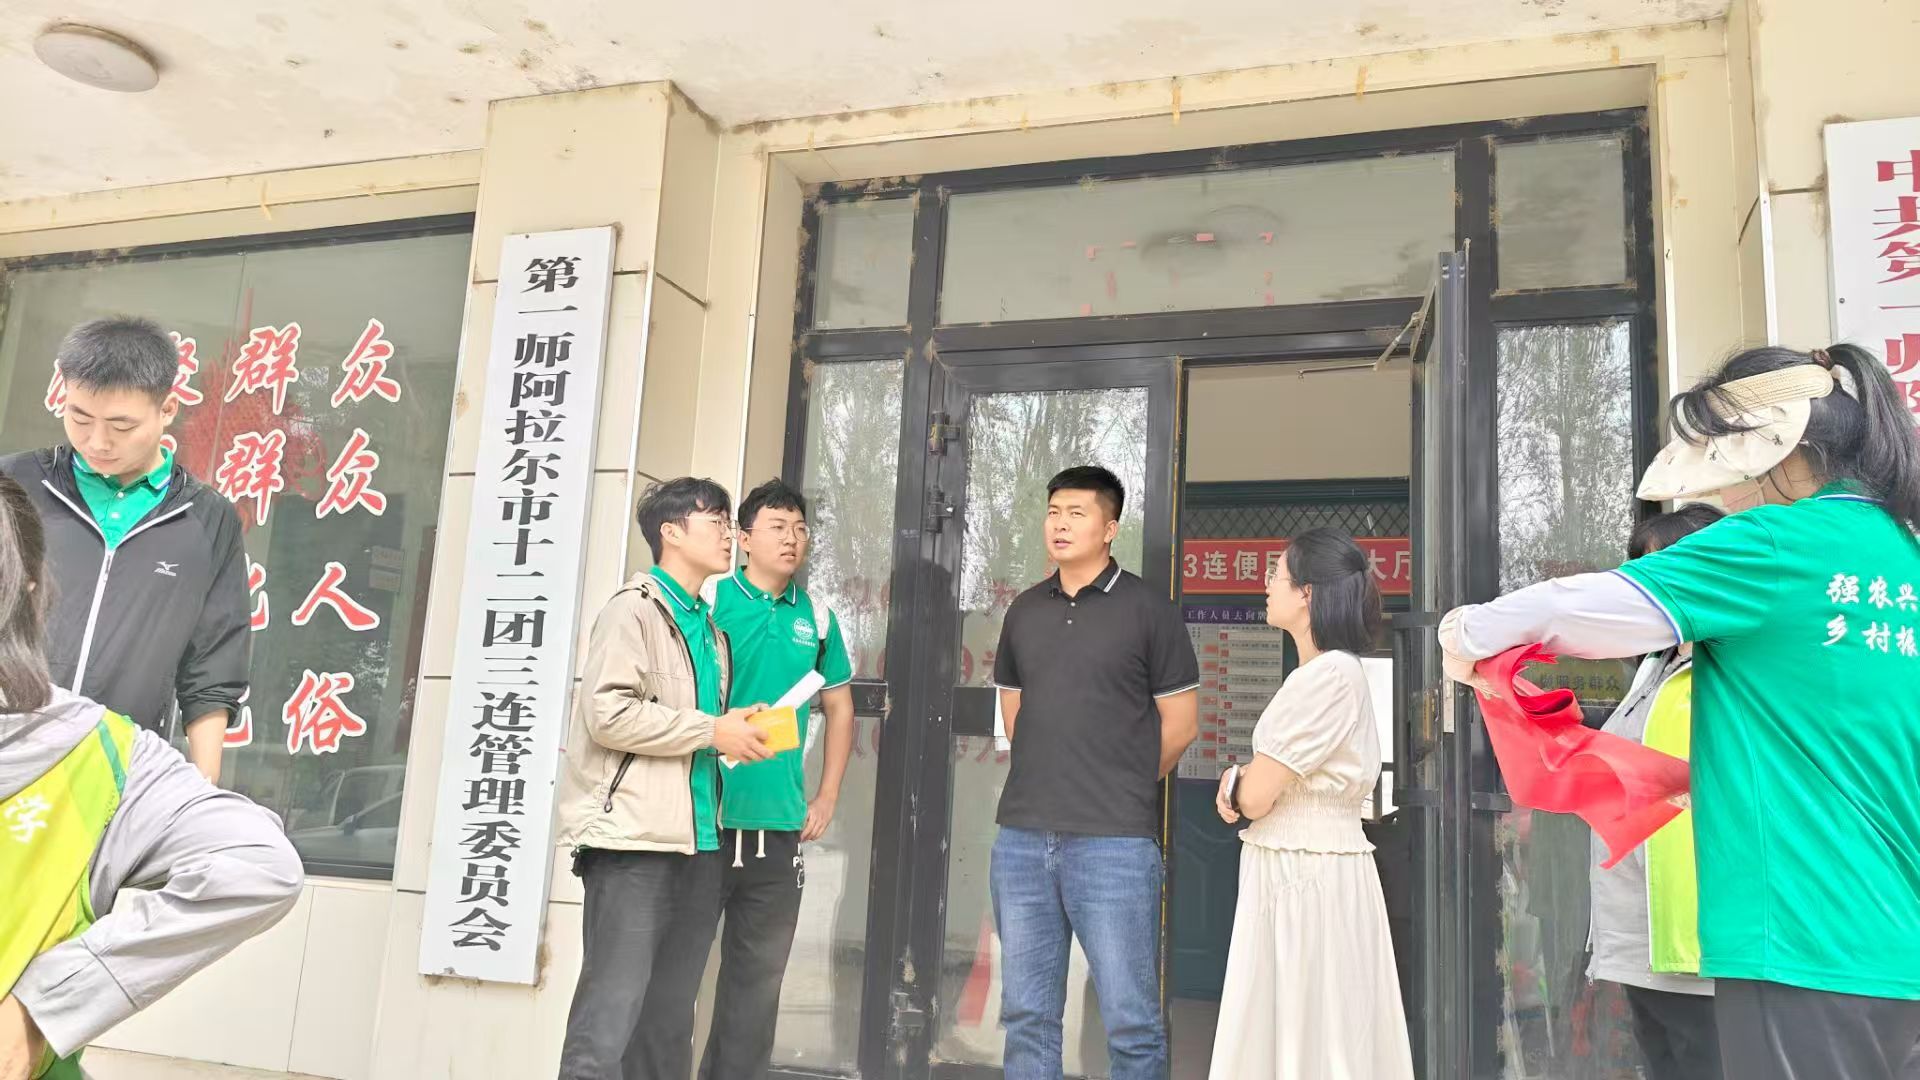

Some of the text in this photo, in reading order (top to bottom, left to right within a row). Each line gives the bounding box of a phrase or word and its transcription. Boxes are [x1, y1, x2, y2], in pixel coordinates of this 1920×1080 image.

[447, 256, 582, 951] 第一师阿拉尔市十二团三连管理委员会
[1826, 573, 1919, 612] 强农兴
[1822, 614, 1919, 657] 乡村振
[3, 794, 52, 844] 学
